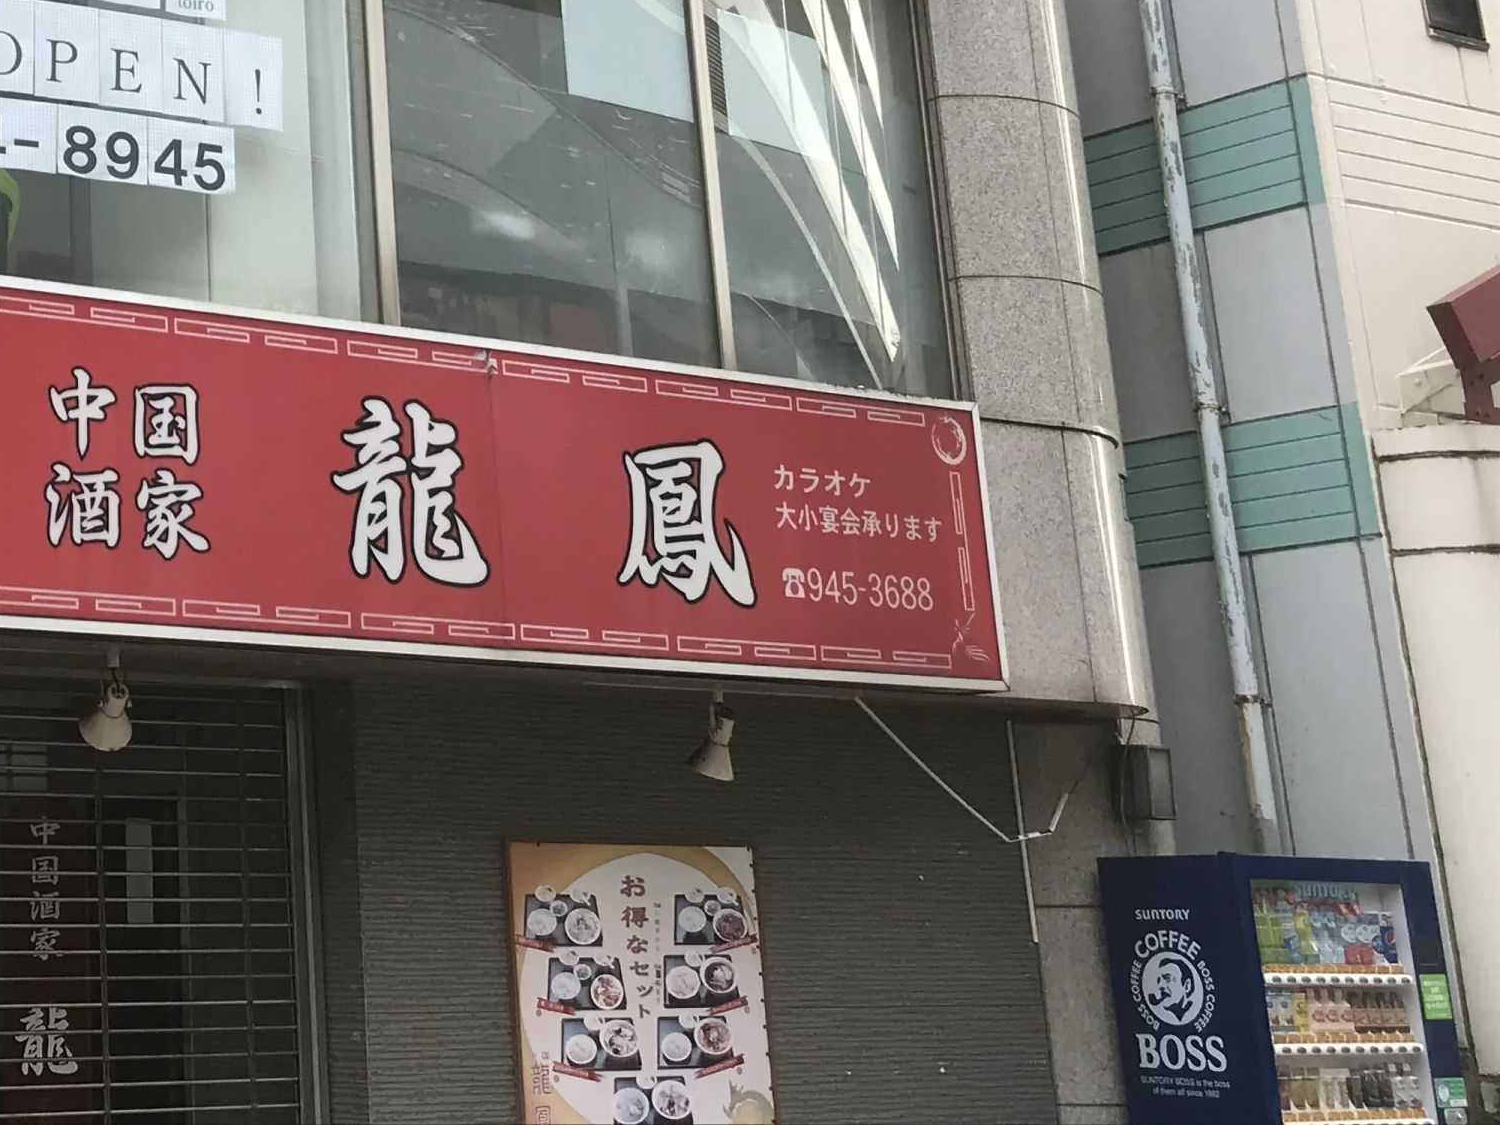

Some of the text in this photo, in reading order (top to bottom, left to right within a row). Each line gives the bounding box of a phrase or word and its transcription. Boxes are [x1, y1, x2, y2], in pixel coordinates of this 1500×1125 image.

[48, 365, 199, 465] 中国
[773, 464, 872, 499] カラオケ
[45, 462, 212, 561] 酒家
[775, 504, 943, 542] 大小宴会承ります
[806, 568, 935, 612] 945-3688
[29, 816, 64, 961] 中国酒家
[620, 875, 654, 1019] お得なセット
[1134, 929, 1202, 962] COFFEE
[1130, 959, 1142, 1002] COFFEE
[1196, 960, 1215, 991] BOSS
[1134, 1033, 1228, 1073] BOSS
